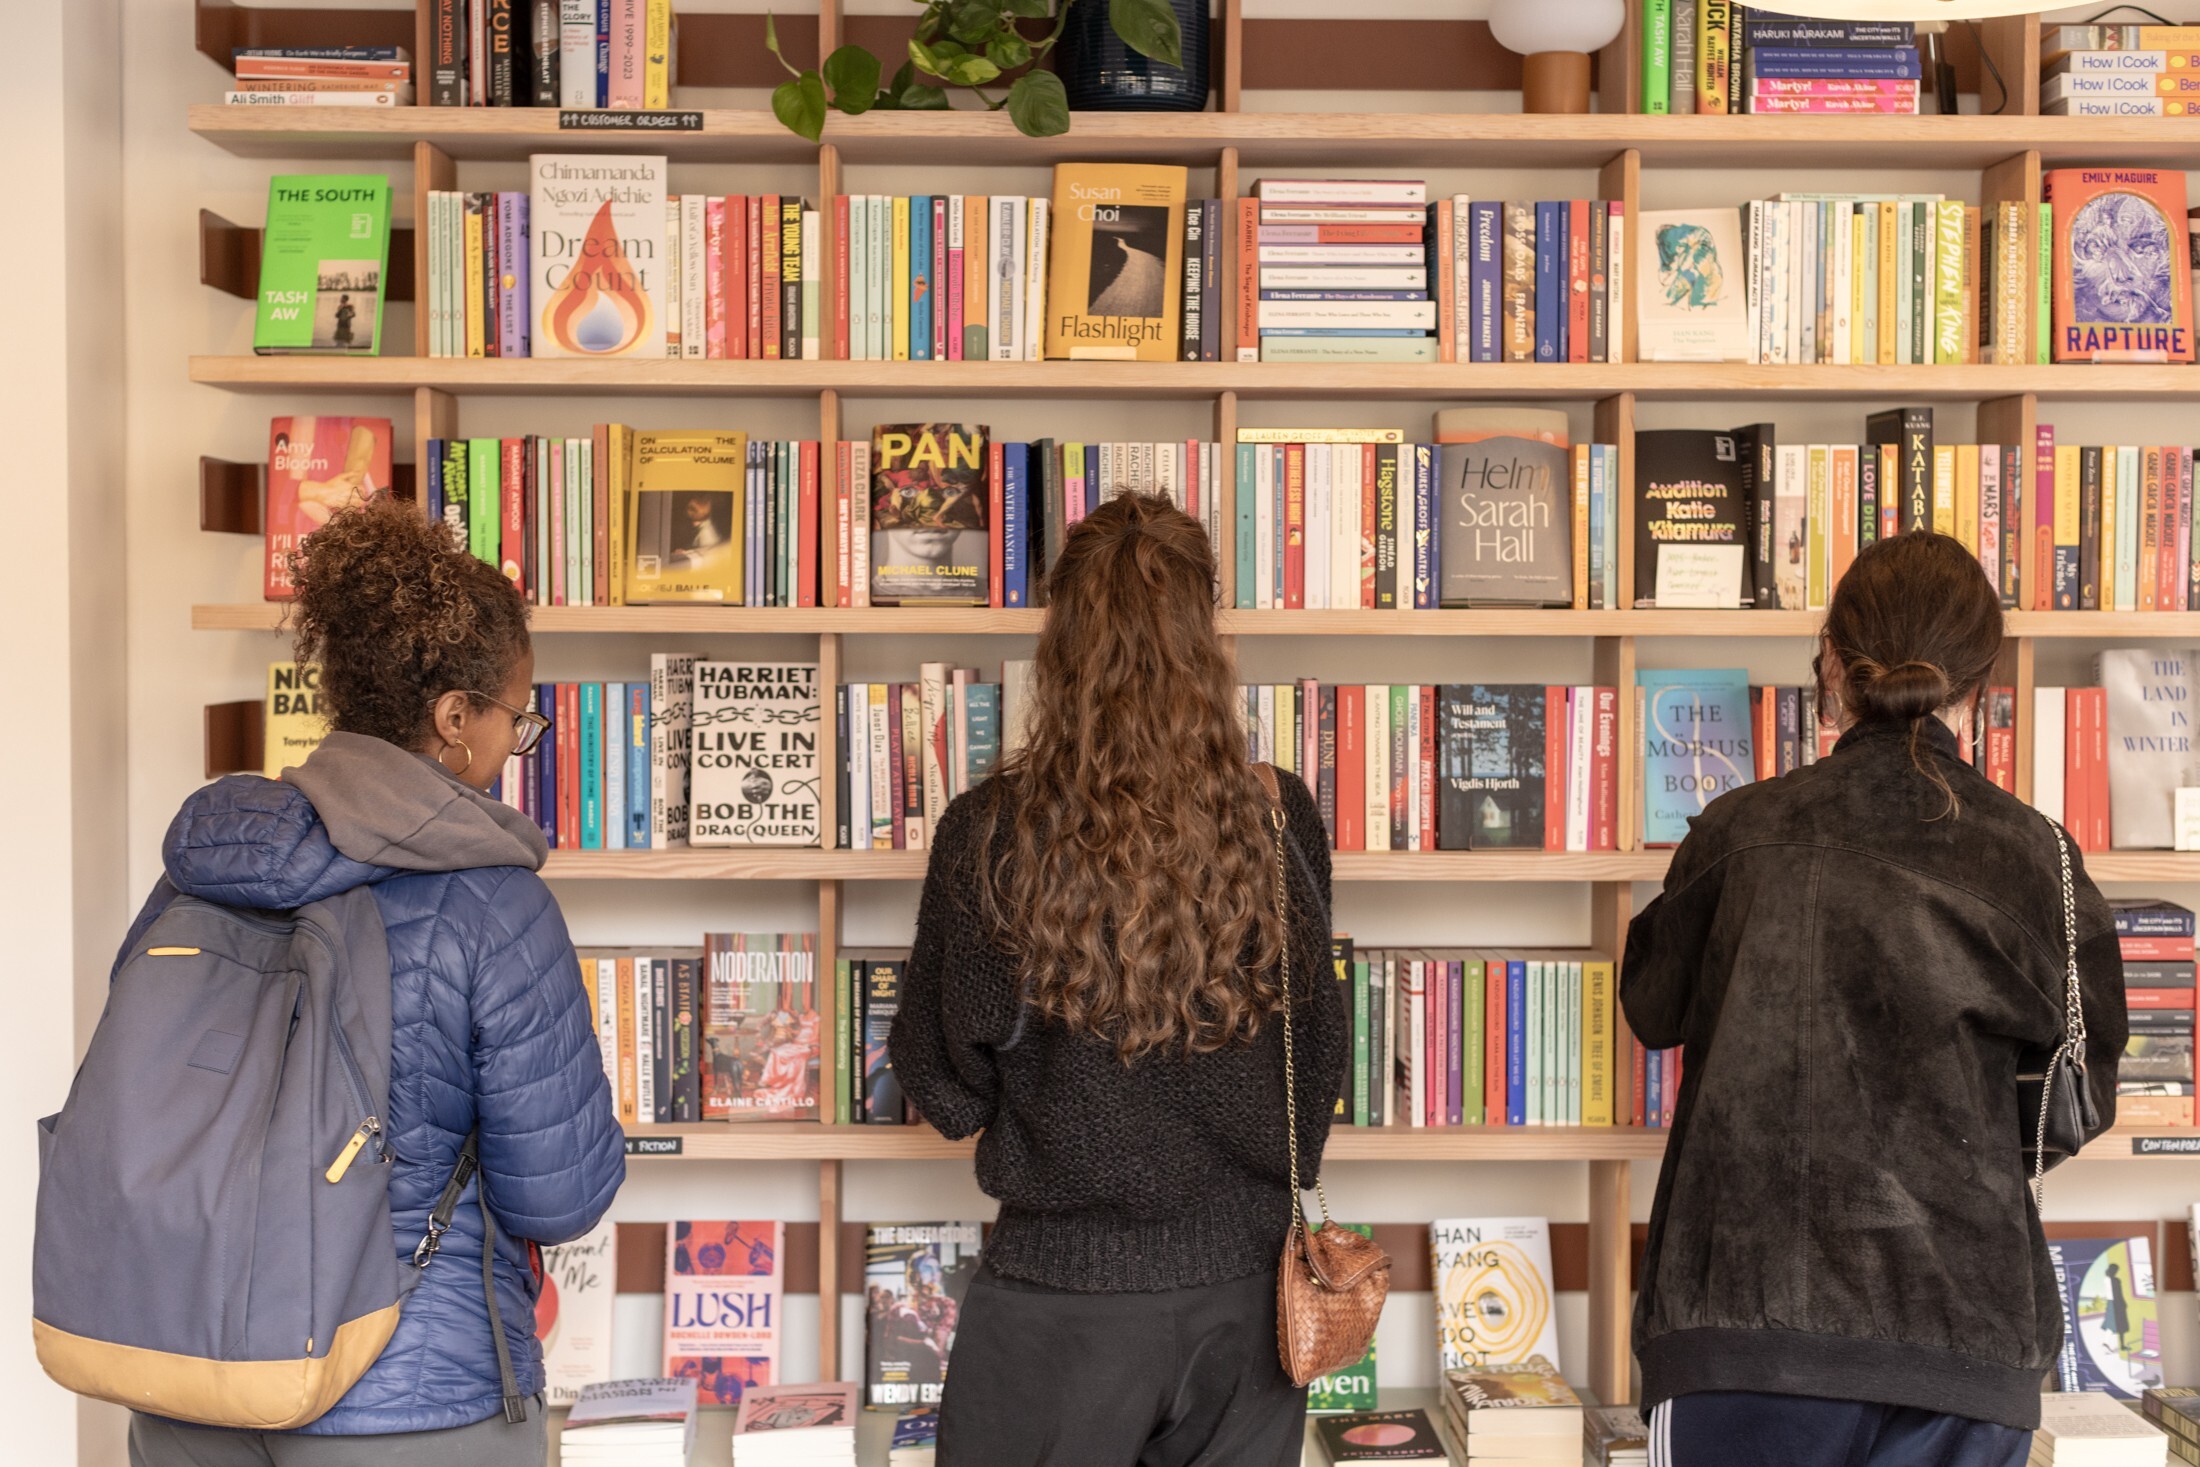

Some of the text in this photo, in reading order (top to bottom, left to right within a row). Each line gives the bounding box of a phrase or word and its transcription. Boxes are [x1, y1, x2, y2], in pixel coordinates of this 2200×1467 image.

[442, 15, 453, 65] NOTHING
[1753, 29, 1844, 39] HARUKI MURAKAMI
[1675, 7, 1694, 92] Sarah Hall
[2082, 56, 2113, 69] How
[2122, 55, 2158, 68] Cook
[2073, 78, 2103, 90] How
[2112, 78, 2148, 90] Cook
[2079, 102, 2110, 114] How
[2119, 102, 2155, 114] Cook
[581, 114, 678, 127] CUSTOMER ORDERS
[539, 162, 655, 181] Chimamanda
[2082, 173, 2158, 184] EMILY MAGUIRE
[277, 188, 376, 202] THE SOUTH
[542, 186, 652, 208] Ngozi Adichie
[1069, 182, 1121, 200] Susan
[1077, 204, 1121, 222] Choi
[541, 229, 654, 259] Dream
[1752, 225, 1760, 249] KANG
[503, 199, 513, 335] YOMI ADEGOKE THE LIST
[1185, 208, 1202, 341] Tice Cin KEEPING THE HOUSE
[1514, 208, 1526, 343] CROSSROADS FRANZEN
[545, 263, 650, 292] Count
[1479, 209, 1495, 348] Freedom JONATHAN FRANZEN
[1937, 203, 1964, 354] STEPHEN KING
[2007, 206, 2018, 354] BARBARA KINGSOLVER UNSHELTERED
[265, 290, 308, 304] TASH
[270, 307, 300, 321] AW
[1060, 314, 1163, 347] Flashlight
[2066, 326, 2186, 353] RAPTURE
[275, 439, 315, 455] Amy
[640, 437, 736, 445] ON THE
[640, 446, 712, 455] CALCULATION
[881, 433, 980, 470] PAN
[275, 455, 328, 471] Bloom
[640, 456, 736, 464] OF VOLUME
[1461, 457, 1550, 491] Helm
[1937, 451, 1952, 509] YELLOWFACE
[1377, 459, 1396, 530] Hagstone
[1645, 480, 1727, 498] Audition
[1459, 493, 1549, 528] Sarah
[1666, 501, 1716, 519] Katie
[1983, 484, 1998, 519] MARS
[854, 448, 867, 592] ELIZA CLARK BOY PARTS
[1648, 520, 1735, 541] Kitamura
[1379, 534, 1387, 571] GLEESON
[1475, 528, 1534, 563] Hall
[877, 565, 978, 577] MICHAEL CLUNE
[2055, 549, 2067, 592] Friends
[2065, 562, 2077, 579] My
[699, 667, 816, 683] HARRIET
[2153, 660, 2185, 676] THE
[700, 685, 817, 700] TUBMAN:
[2143, 686, 2187, 701] LAND
[1451, 705, 1496, 716] Will and
[1669, 705, 1722, 722] THE
[2171, 711, 2187, 726] IN
[1451, 717, 1507, 730] Testament
[698, 732, 815, 751] LIVE IN
[1322, 730, 1335, 769] DUNE
[1647, 733, 1749, 758] MÖBIUS
[2123, 736, 2189, 752] WINTER
[697, 754, 816, 768] CONCERT
[587, 769, 594, 778] OF
[1450, 778, 1520, 791] Vigdis Hjorth
[1664, 775, 1736, 792] BOOK
[696, 803, 815, 820] BOB THE
[696, 824, 814, 838] DRAG QUEEN
[711, 951, 813, 983] MODERATION
[875, 967, 893, 975] OUR
[871, 989, 897, 997] NIGHT
[1592, 971, 1603, 1101] DENIS JOHNSON TREE OF SMOKE
[1513, 1065, 1519, 1076] ME
[1513, 1076, 1519, 1086] GO
[709, 1097, 814, 1107] ELAINE CASTILLO
[639, 1140, 676, 1152] FICTION
[873, 1225, 977, 1244] THE BENEFACTORS
[1434, 1227, 1481, 1245] HAN
[1437, 1250, 1500, 1269] KANG
[563, 1261, 600, 1293] Me
[672, 1292, 772, 1328] LUSH
[1441, 1326, 1475, 1344] DO
[1443, 1350, 1490, 1368] NOT
[871, 1383, 919, 1403] WENDY
[1368, 1412, 1416, 1421] MARK
